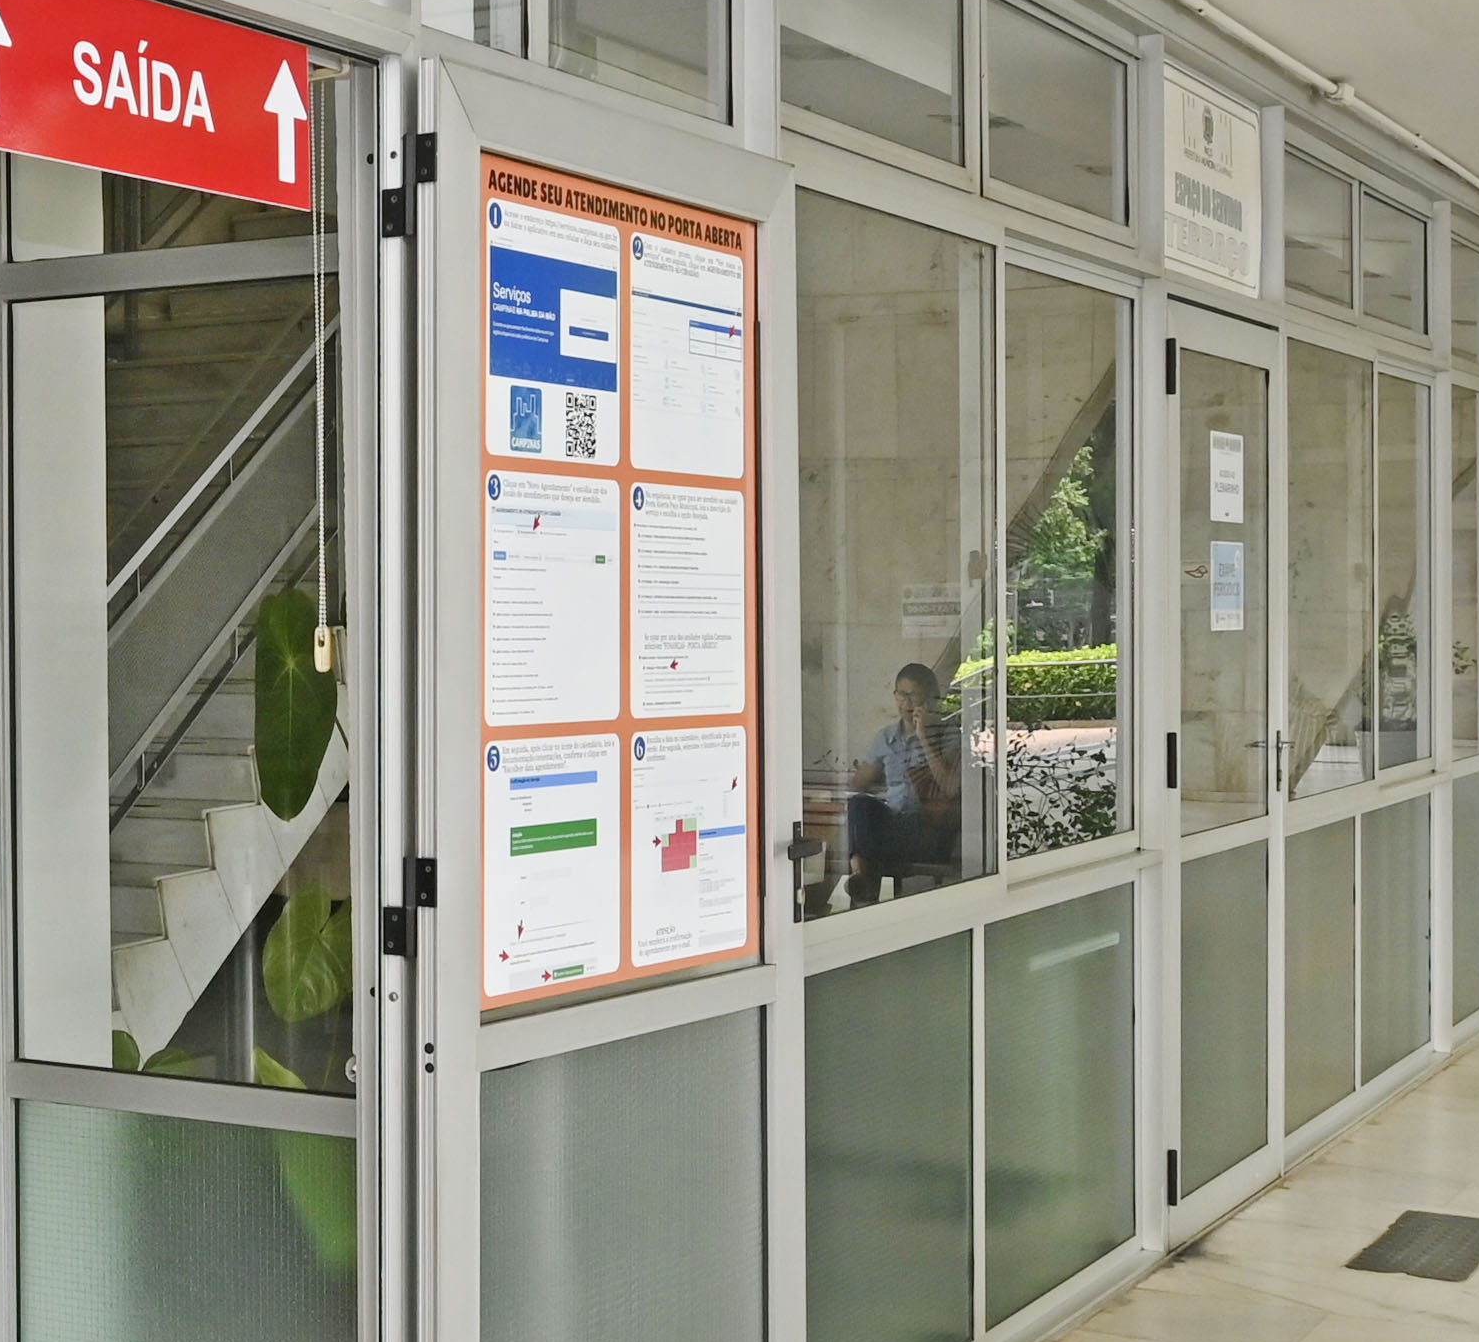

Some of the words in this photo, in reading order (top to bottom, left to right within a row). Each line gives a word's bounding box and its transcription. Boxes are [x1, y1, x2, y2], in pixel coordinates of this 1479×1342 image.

[72, 39, 215, 134] SAÍDA
[488, 169, 537, 200] AGENDE
[540, 182, 562, 206] SEU
[565, 189, 648, 227] ATENDIMENTO
[650, 210, 666, 231] NO
[668, 215, 702, 241] PORTA
[704, 225, 742, 250] ABERTA
[493, 281, 531, 306] Serviços
